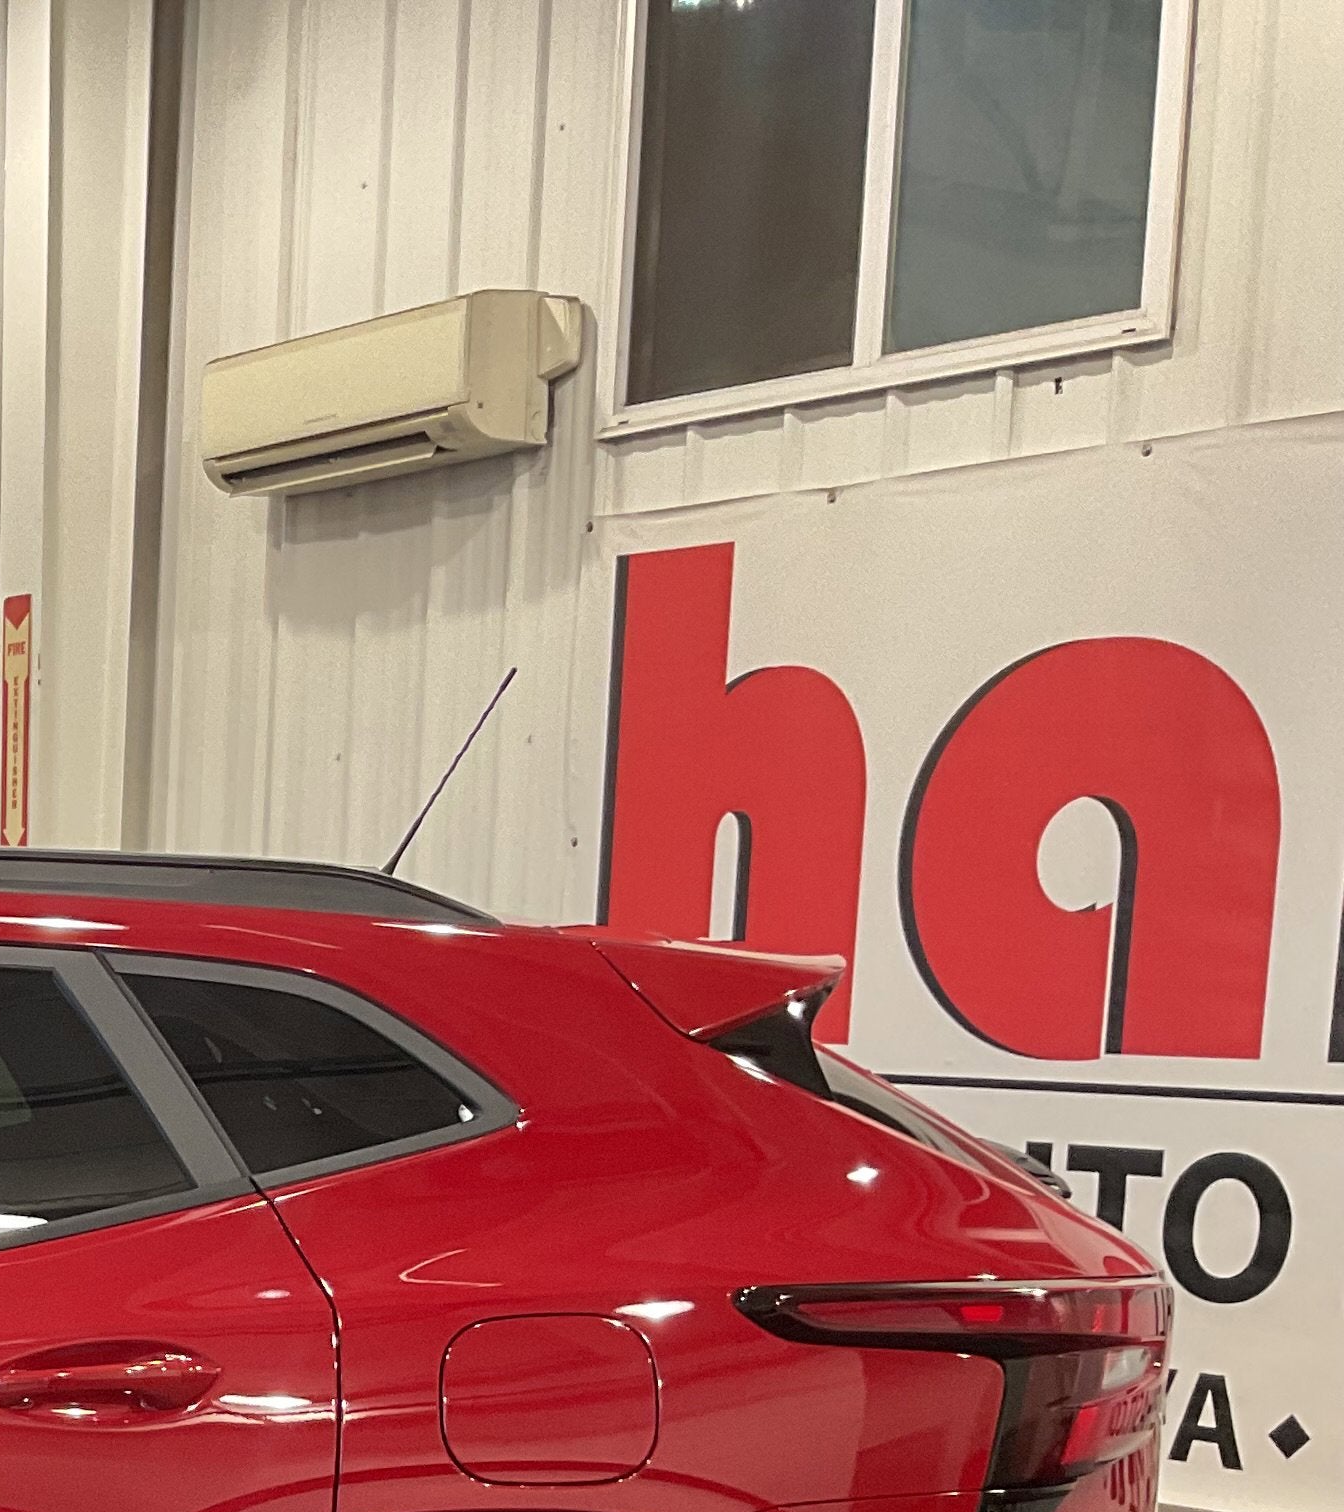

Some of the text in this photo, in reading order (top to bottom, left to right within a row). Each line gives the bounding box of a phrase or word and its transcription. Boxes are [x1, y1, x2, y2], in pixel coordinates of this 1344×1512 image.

[7, 641, 26, 656] FIRE
[12, 676, 20, 810] EXTINGUISHER
[596, 541, 1344, 1062] ha
[1025, 1141, 1293, 1304] TO
[1163, 1369, 1244, 1472] A
